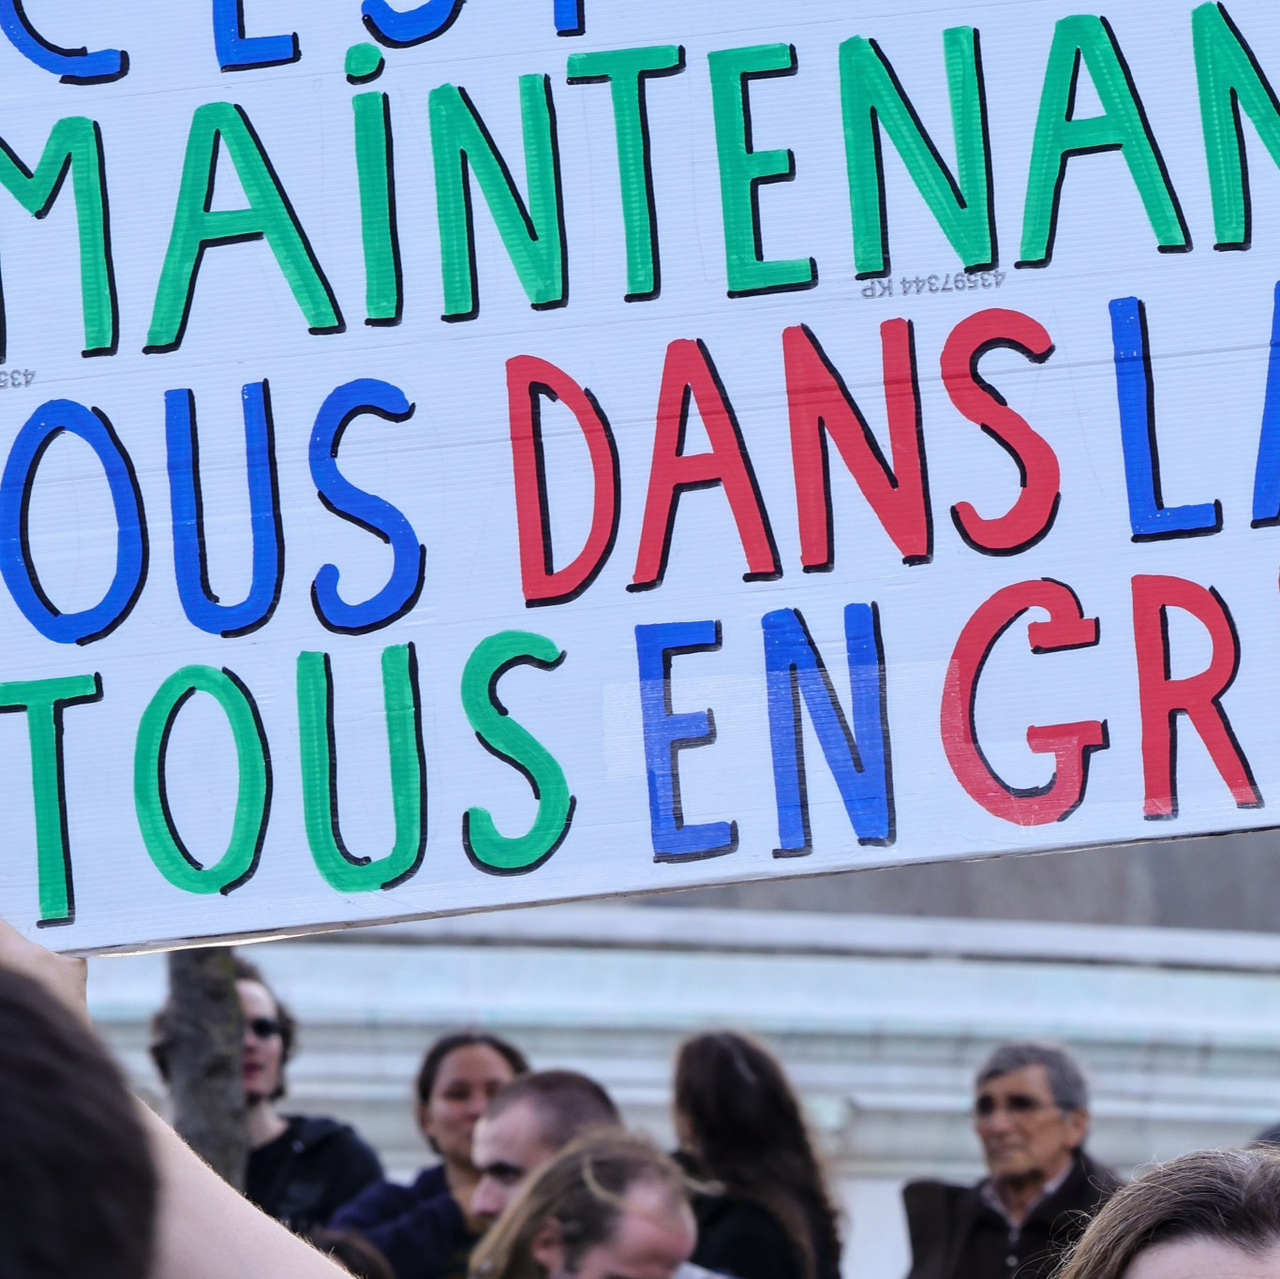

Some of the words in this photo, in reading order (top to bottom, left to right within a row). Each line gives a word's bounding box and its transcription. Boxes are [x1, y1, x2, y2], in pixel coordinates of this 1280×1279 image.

[860, 278, 895, 300] KP
[505, 307, 1062, 607] DANS
[0, 629, 577, 928] TOUS
[634, 600, 897, 863] EN
